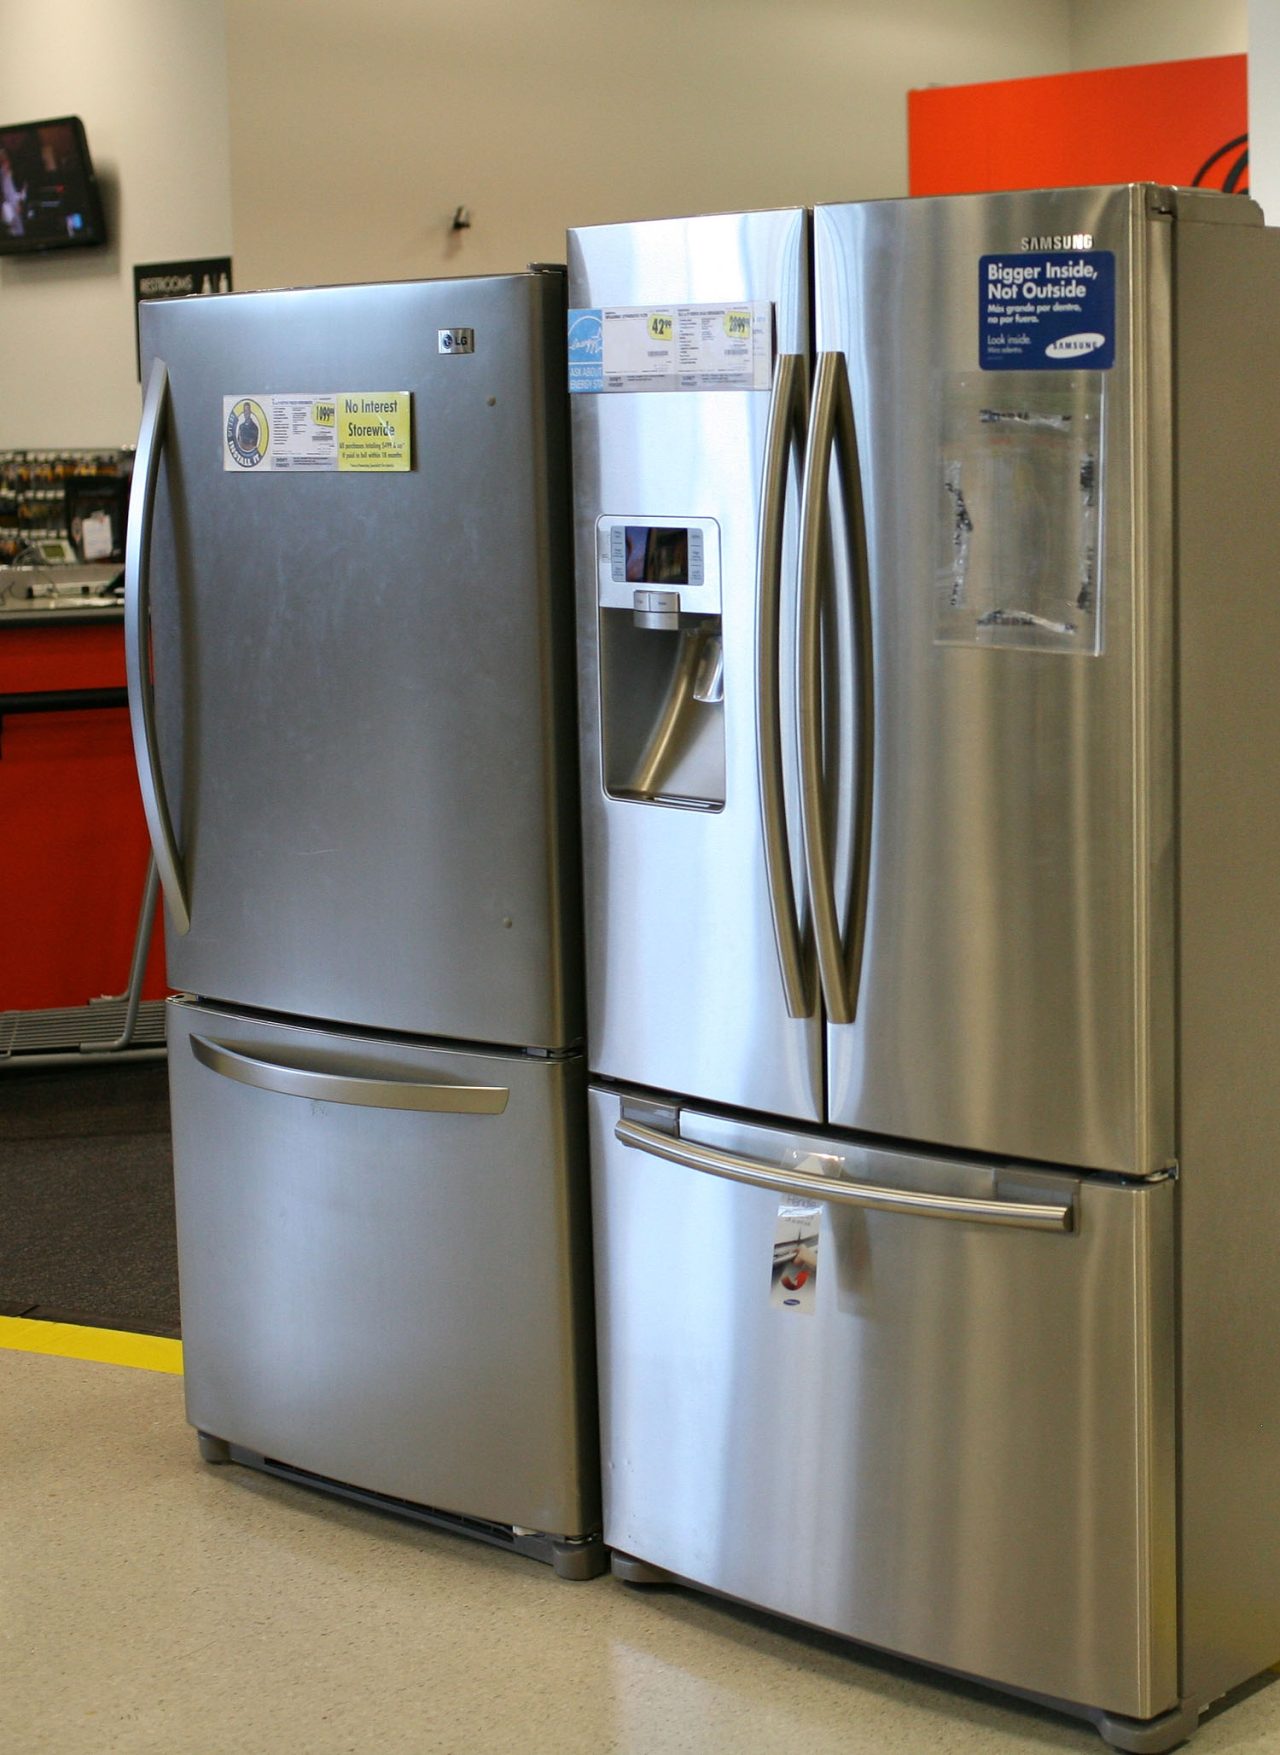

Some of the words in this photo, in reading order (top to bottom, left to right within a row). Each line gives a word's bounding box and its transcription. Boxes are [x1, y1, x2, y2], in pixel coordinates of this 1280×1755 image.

[1021, 234, 1093, 250] SAMSUNG
[988, 262, 1041, 284] Bigger
[1046, 260, 1098, 280] Inside,
[988, 283, 1018, 299] Not
[1022, 280, 1087, 299] Outside
[1006, 302, 1035, 315] grande
[1037, 304, 1051, 314] por
[987, 316, 998, 324] no
[999, 316, 1014, 325] por
[455, 336, 468, 346] LG
[987, 334, 1006, 345] Look
[345, 399, 358, 413] No
[361, 399, 397, 413] Interest
[348, 421, 395, 437] Storewide
[227, 440, 253, 467] INSTALL
[252, 452, 261, 464] IT
